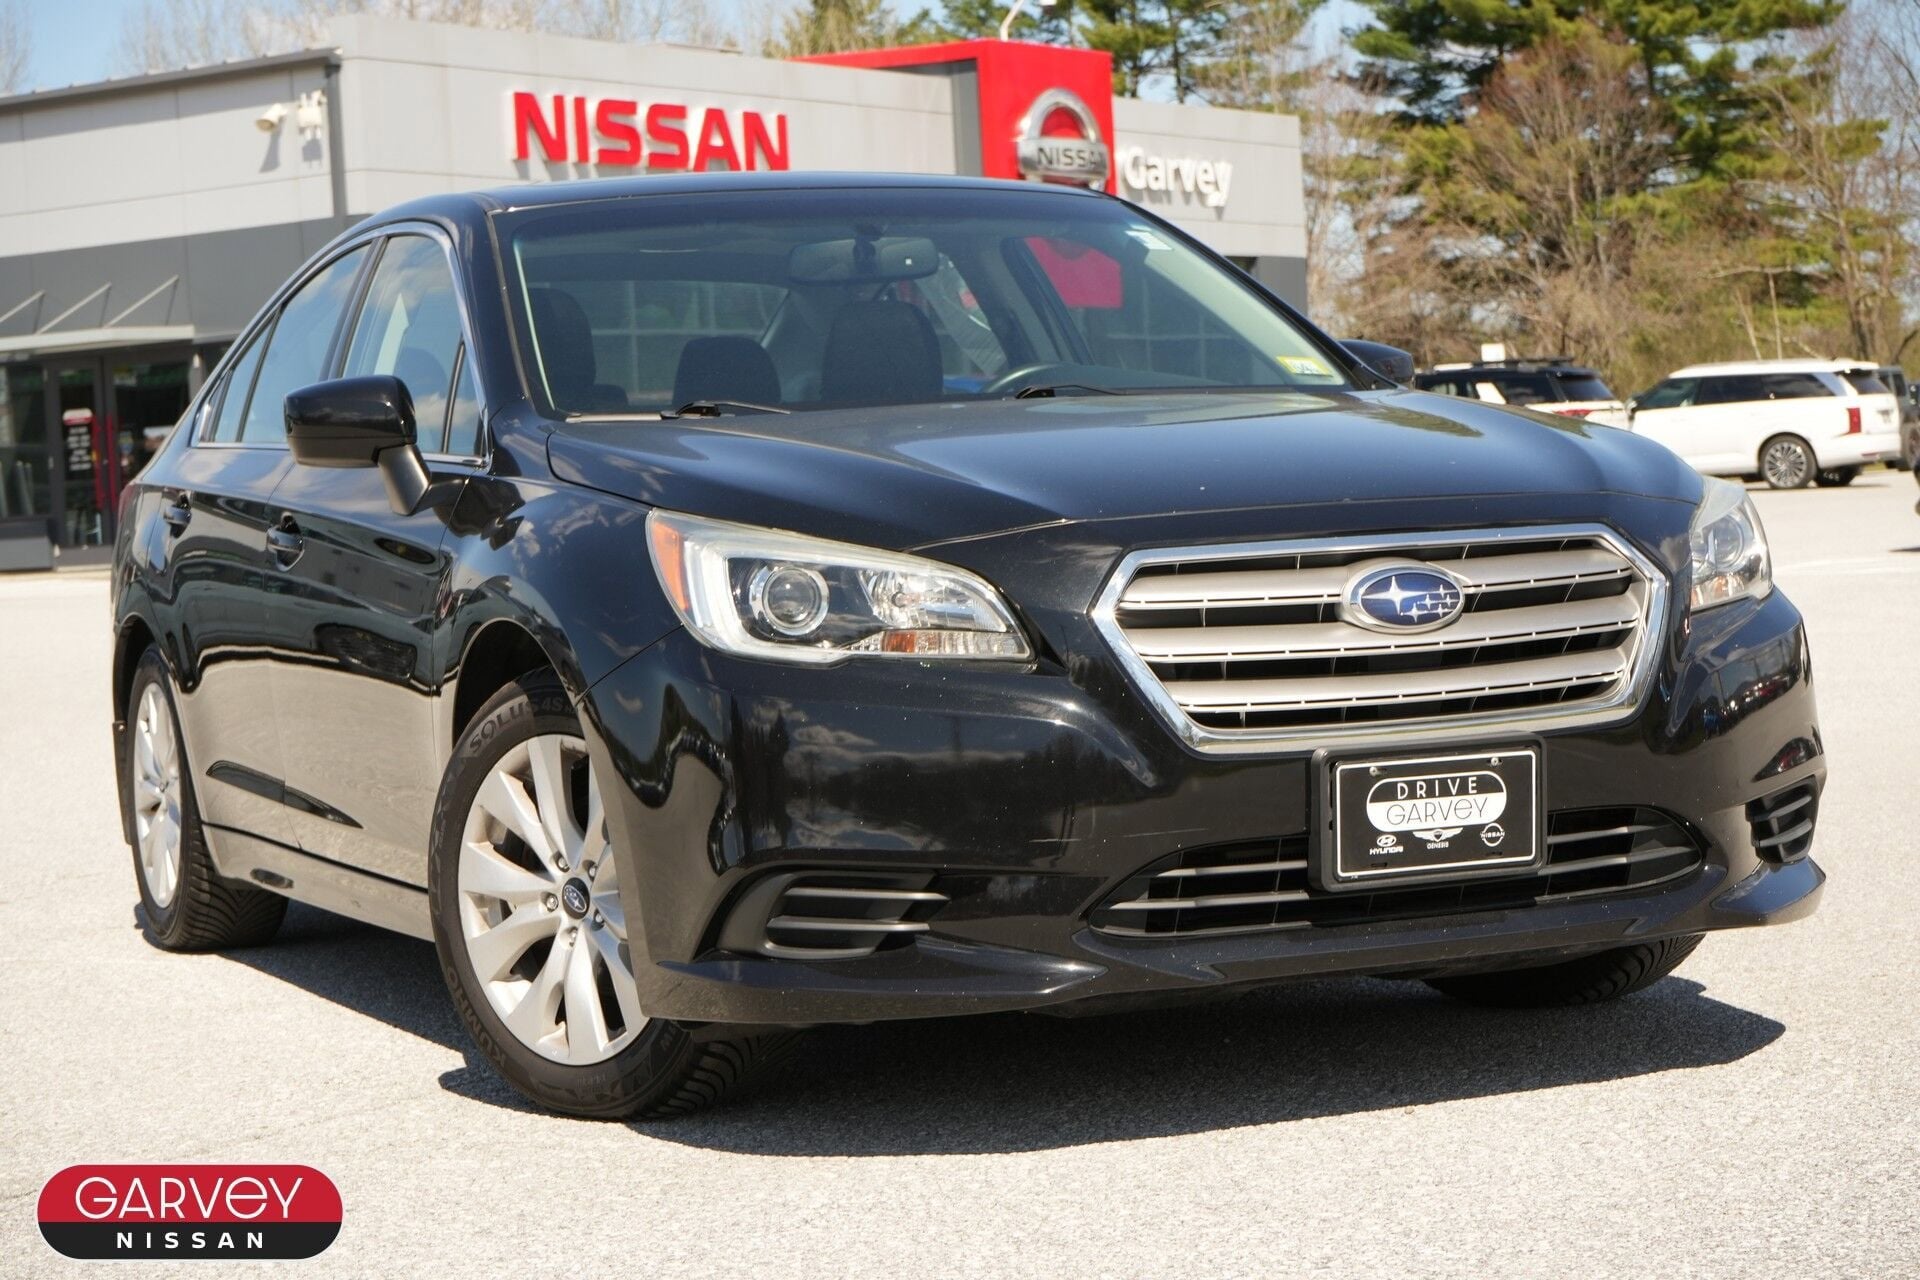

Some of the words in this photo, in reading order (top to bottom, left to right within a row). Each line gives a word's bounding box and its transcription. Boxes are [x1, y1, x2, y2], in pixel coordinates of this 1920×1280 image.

[514, 92, 790, 172] NISSAN
[1124, 147, 1232, 207] Garvey
[1397, 776, 1477, 800] DRIVE
[1480, 830, 1505, 839] NISSAN
[1369, 845, 1404, 855] HYUNDAI
[1426, 841, 1449, 850] GENESIS
